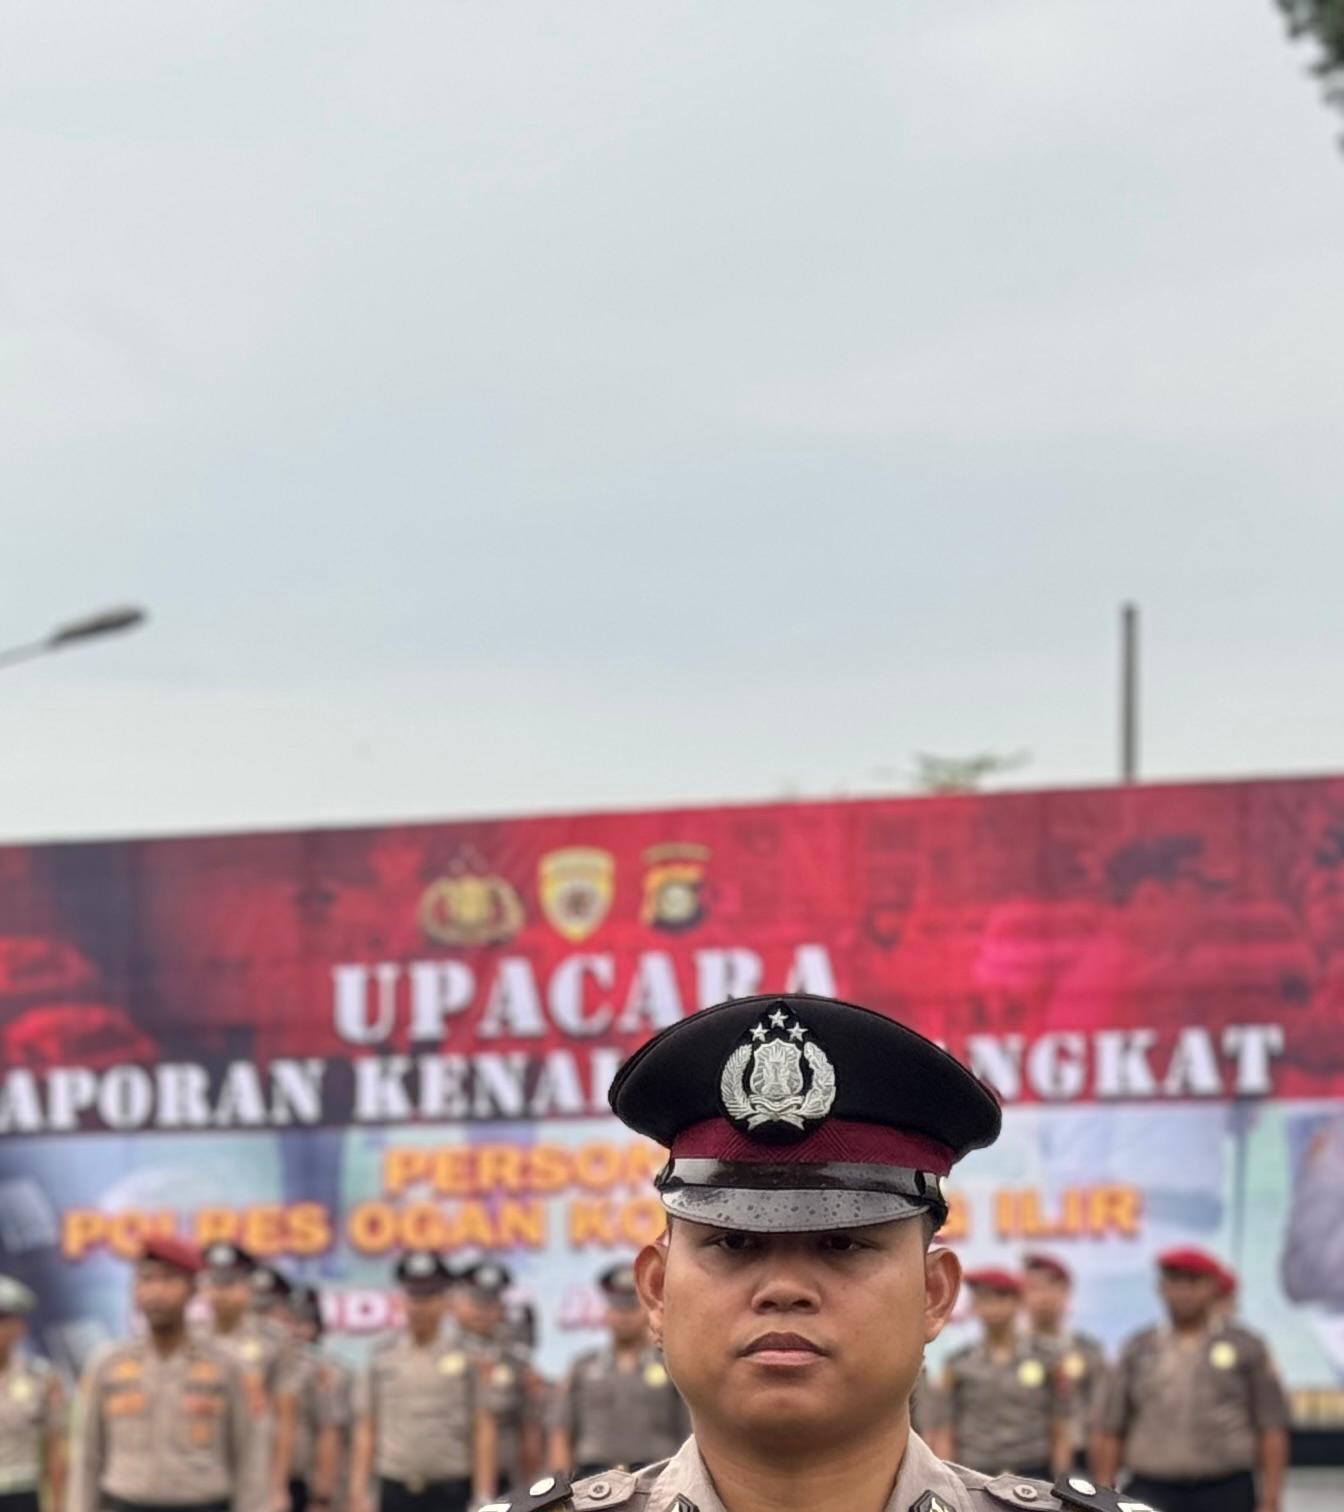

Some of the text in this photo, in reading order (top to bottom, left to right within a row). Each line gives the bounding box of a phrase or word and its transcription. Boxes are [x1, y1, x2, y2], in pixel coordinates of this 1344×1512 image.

[937, 1024, 1285, 1098] NGKAT
[347, 1200, 545, 1254] OGAN
[993, 1184, 1142, 1240] ILIR
